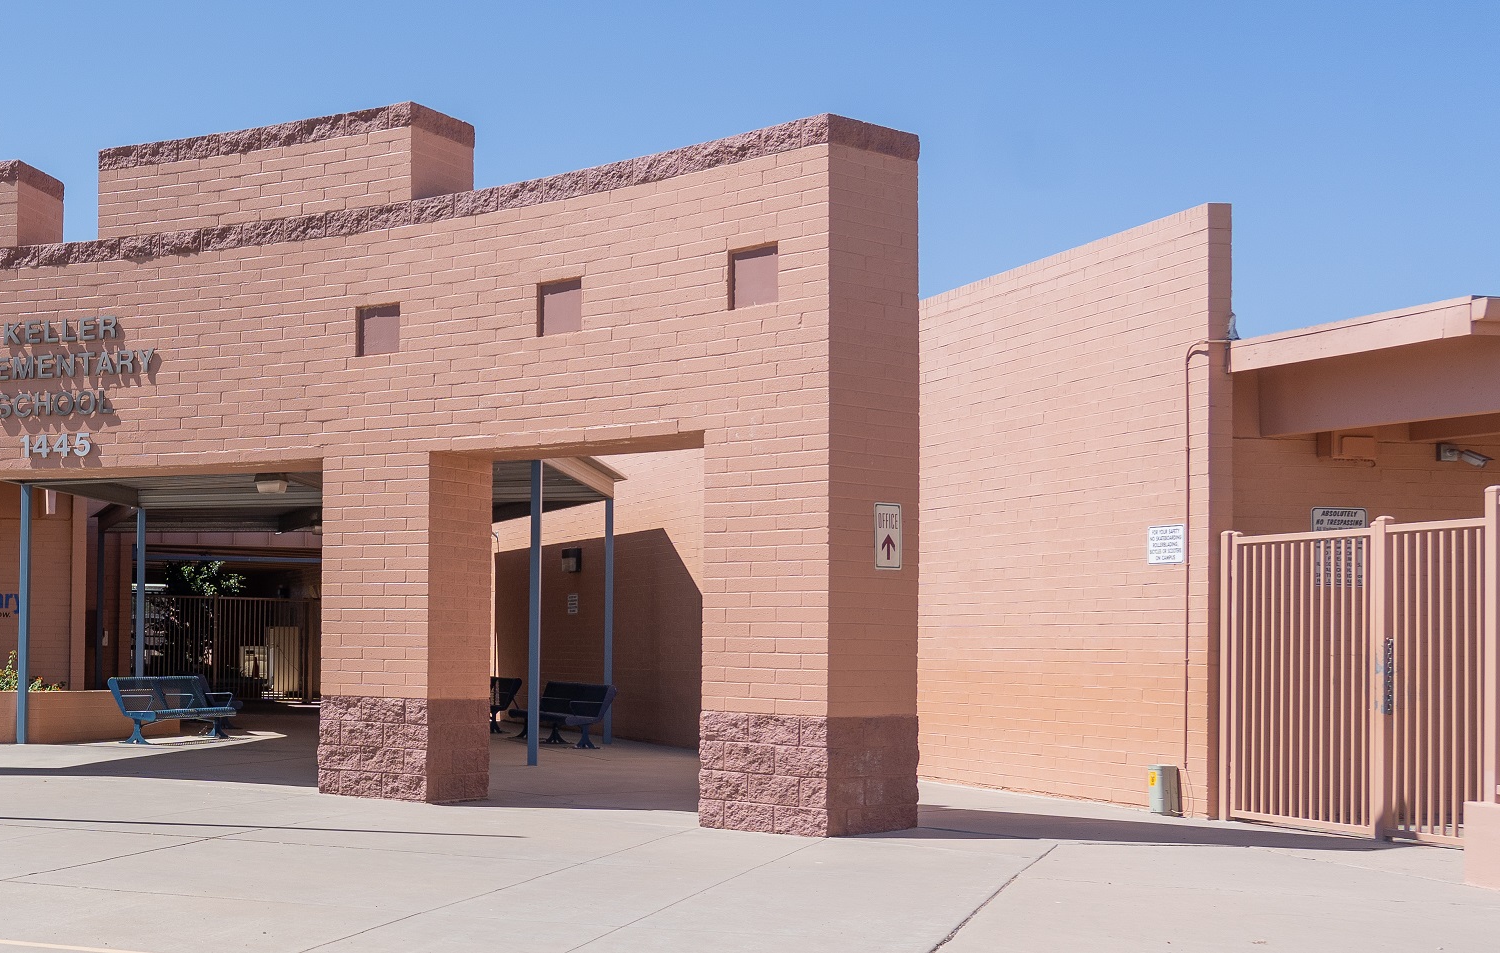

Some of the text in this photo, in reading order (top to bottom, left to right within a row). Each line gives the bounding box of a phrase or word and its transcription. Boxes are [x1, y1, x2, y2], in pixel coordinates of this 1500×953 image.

[3, 315, 118, 346] KELLER
[19, 432, 92, 459] 1445
[878, 512, 899, 530] OFFICE
[1315, 518, 1363, 527] NO TRESPASSING
[1321, 510, 1358, 518] ABSOLUTELY
